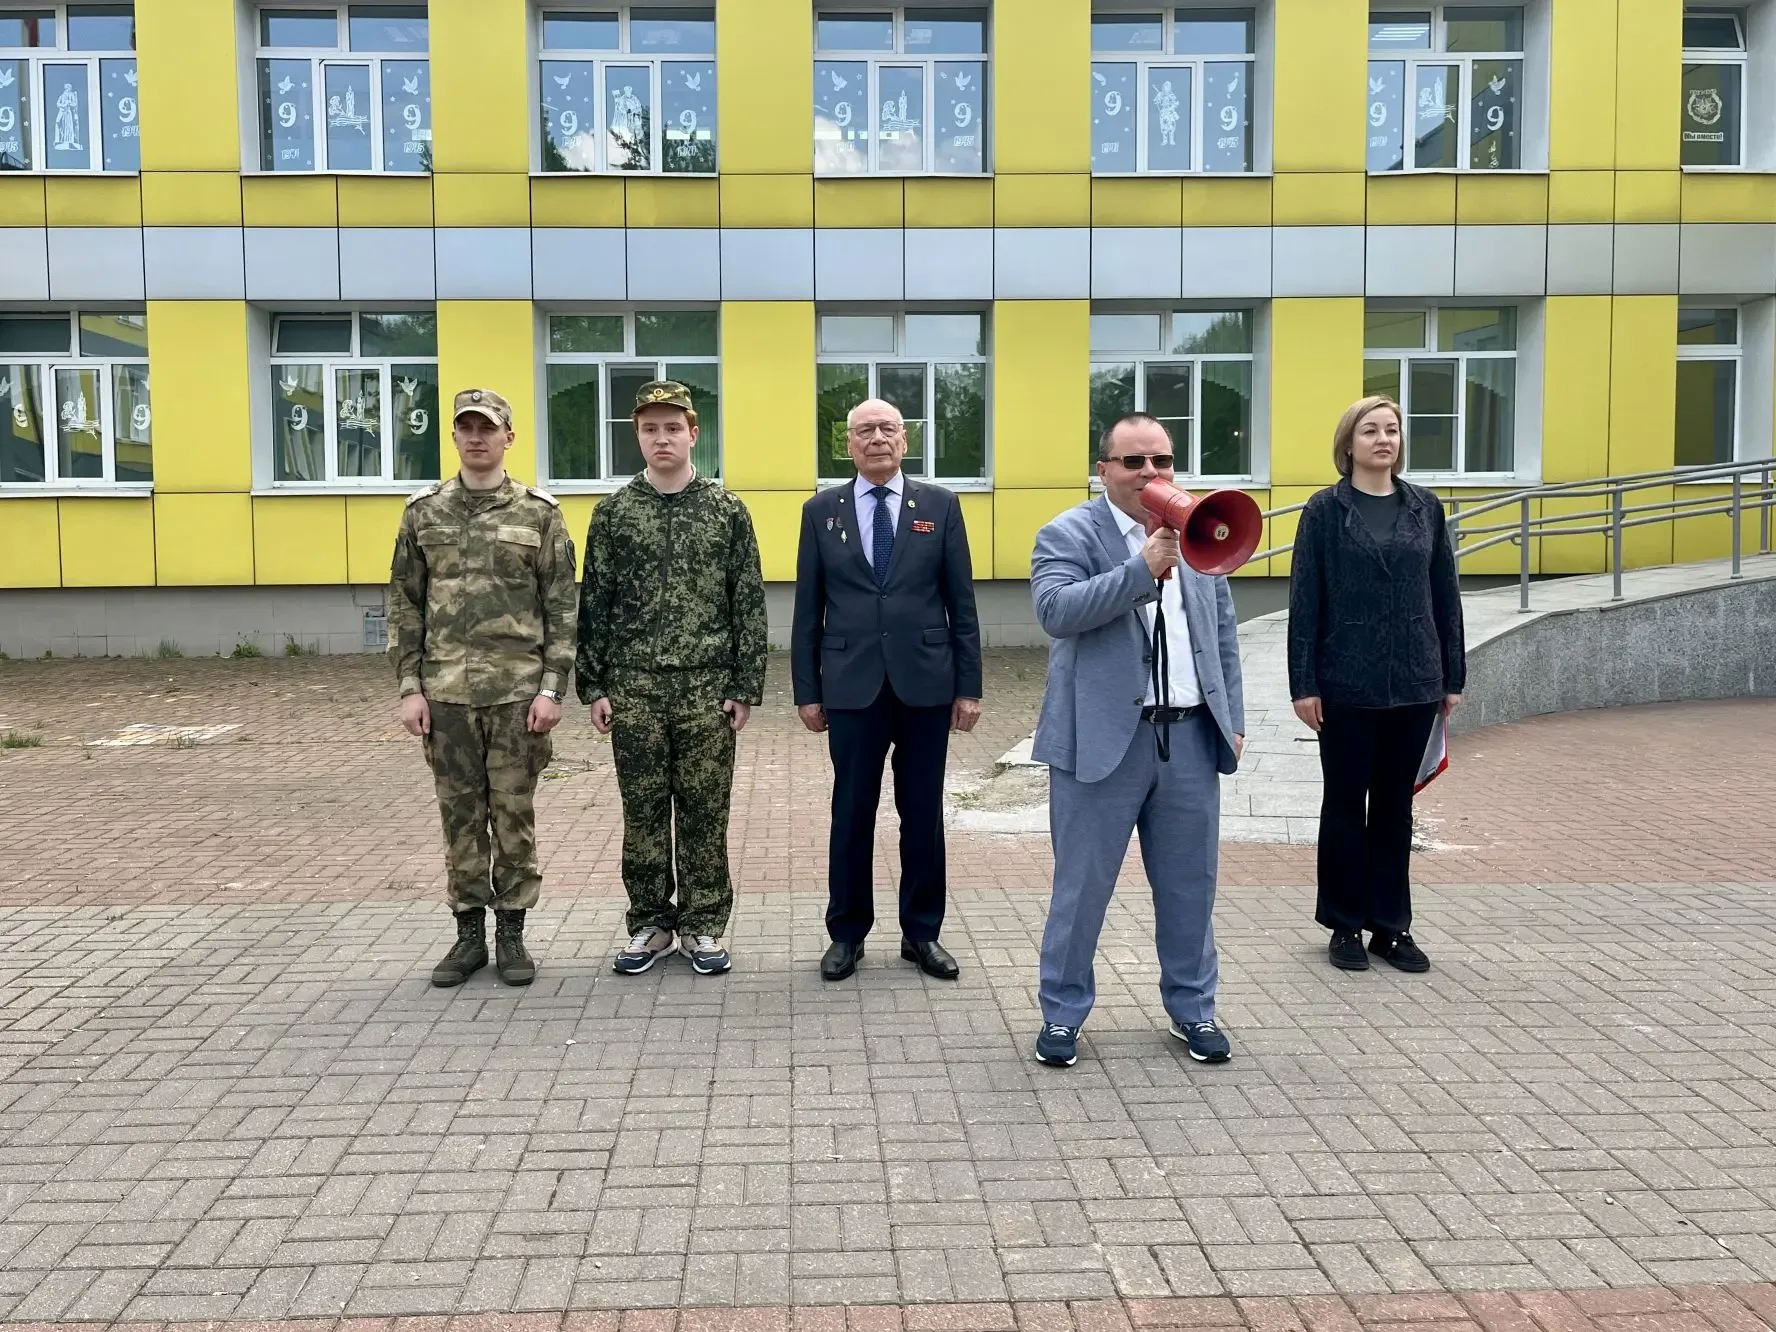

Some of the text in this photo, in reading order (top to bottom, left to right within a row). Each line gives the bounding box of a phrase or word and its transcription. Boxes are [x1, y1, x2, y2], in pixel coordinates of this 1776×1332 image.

[118, 97, 136, 123] 9
[278, 102, 296, 128] 9
[835, 102, 852, 126] 9
[954, 102, 972, 128] 9
[1105, 91, 1122, 116] 9
[1370, 102, 1387, 127] 9
[0, 106, 15, 132] 9
[404, 104, 422, 130] 9
[560, 110, 578, 136] 9
[680, 109, 697, 134] 9
[1221, 105, 1238, 131] 9
[1487, 105, 1505, 131] 9
[134, 404, 151, 431] 9
[291, 404, 308, 431] 9
[411, 408, 429, 435] 9
